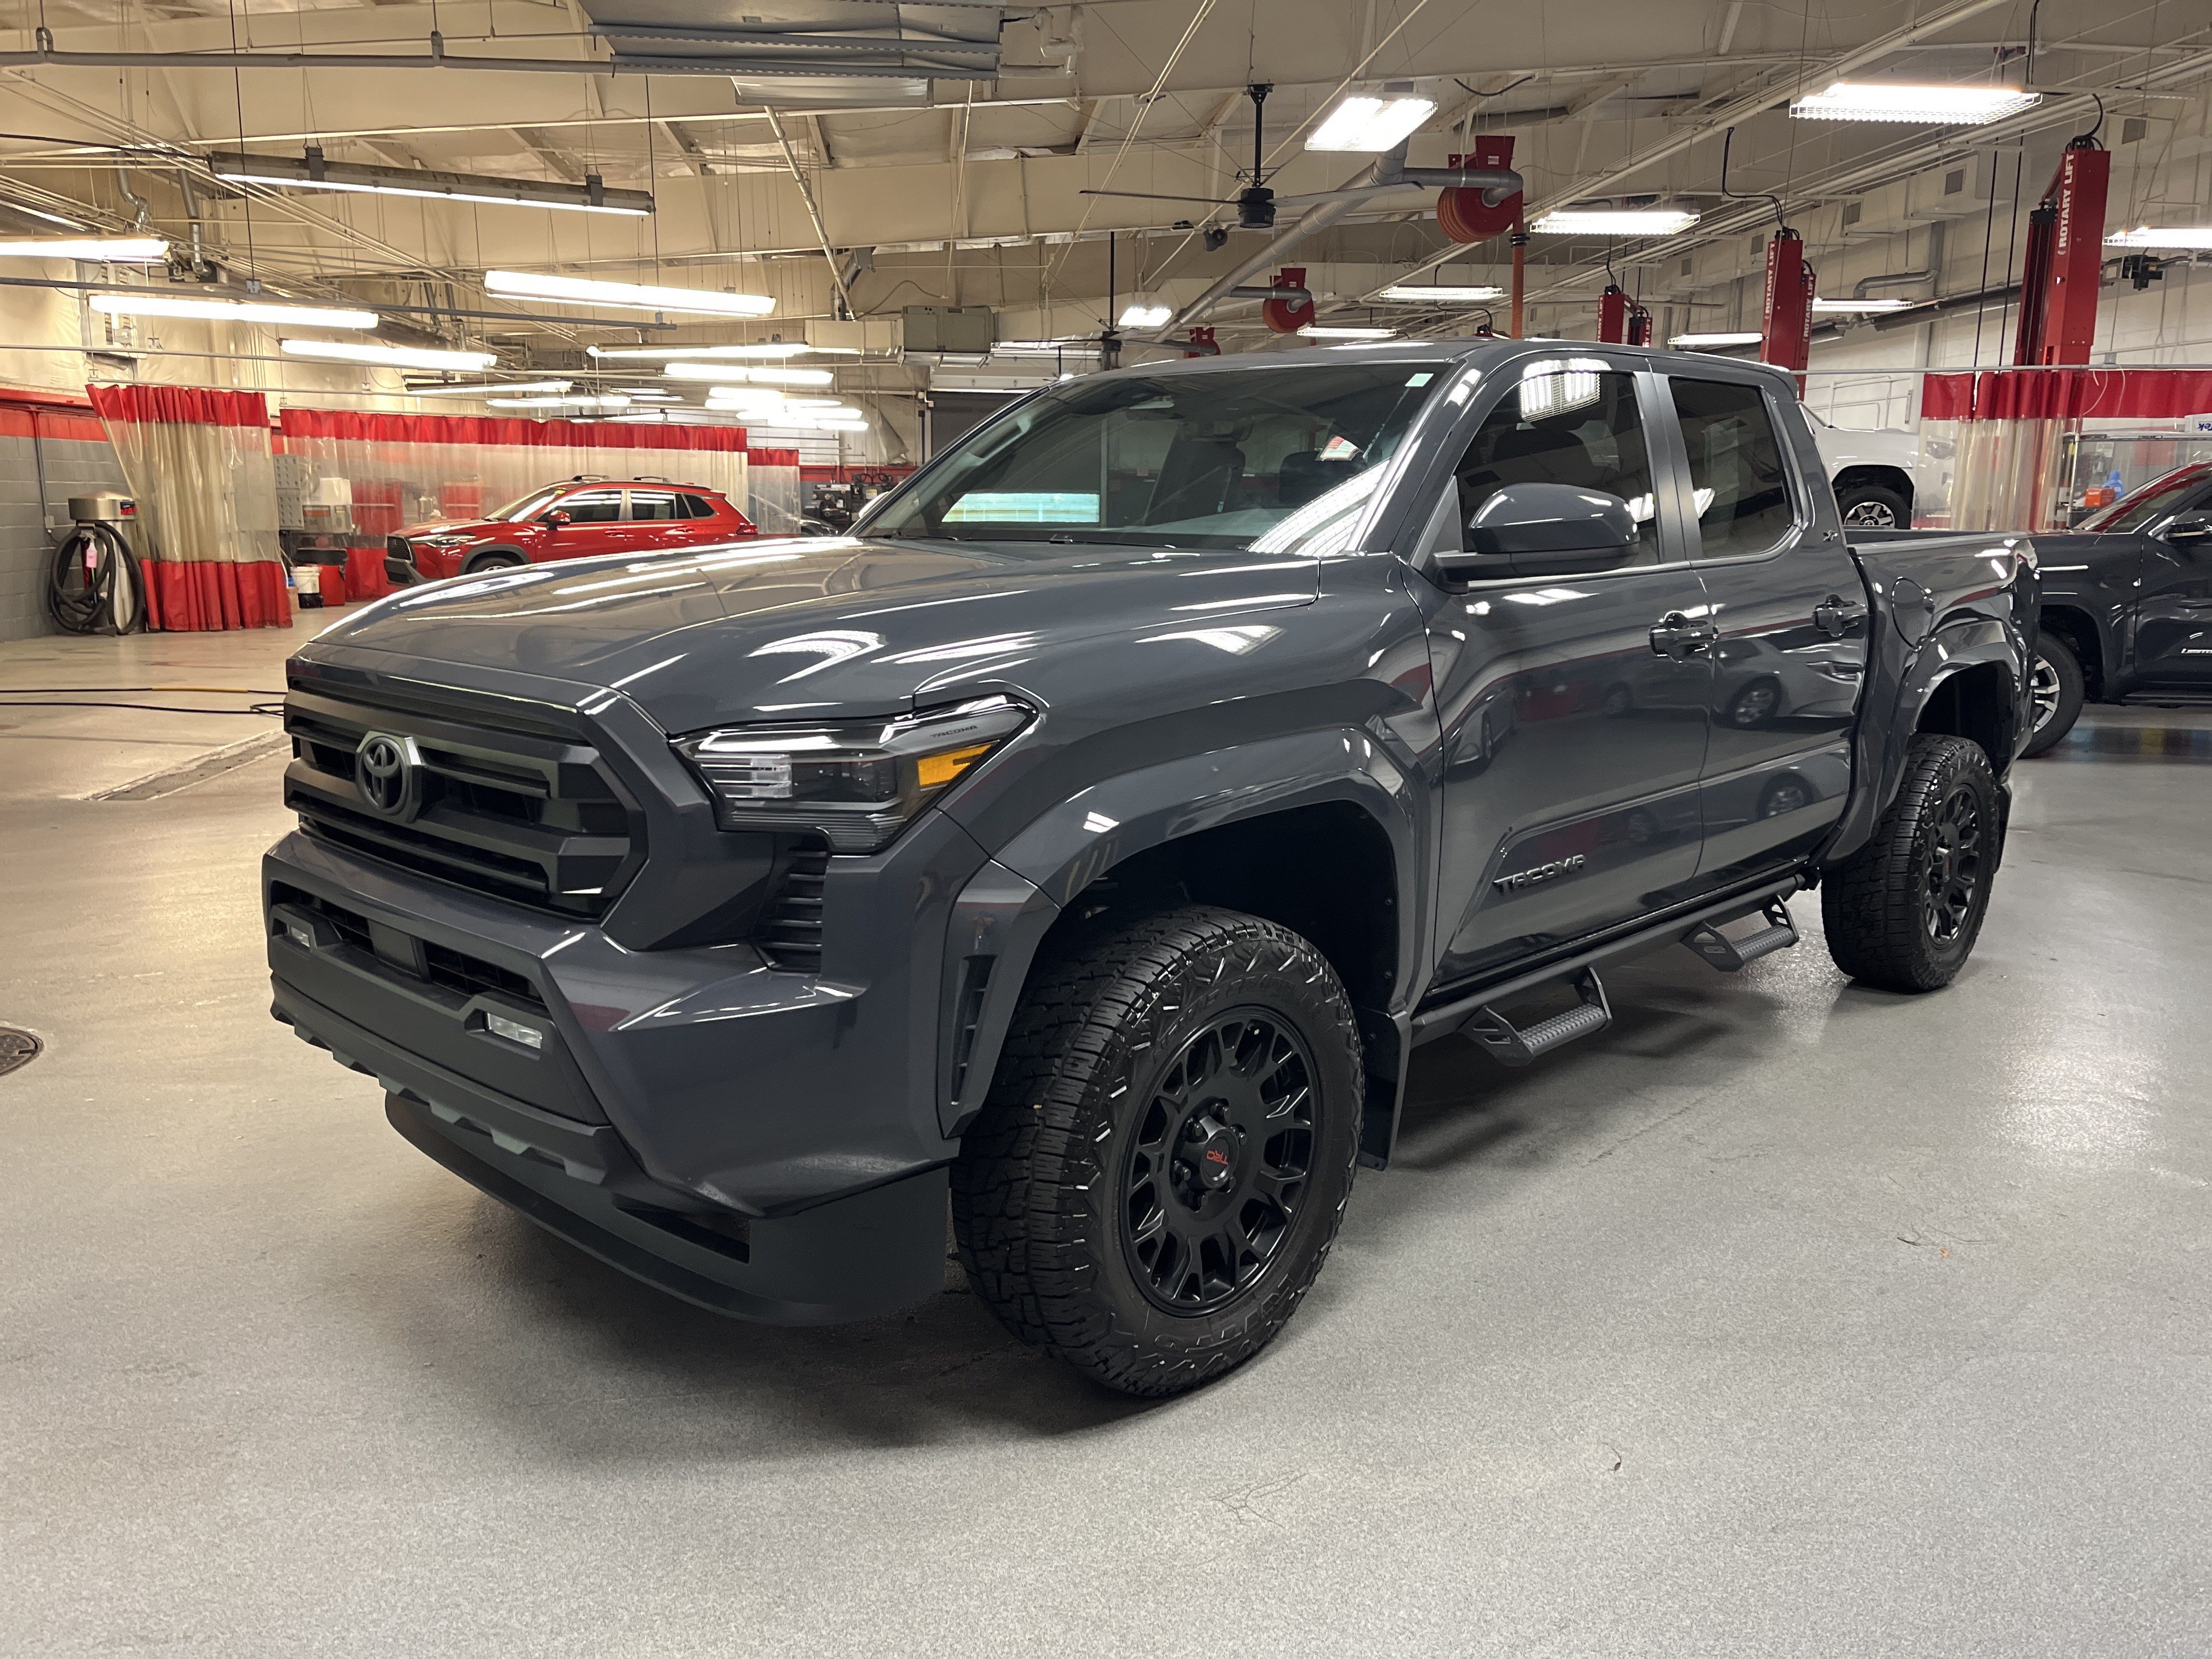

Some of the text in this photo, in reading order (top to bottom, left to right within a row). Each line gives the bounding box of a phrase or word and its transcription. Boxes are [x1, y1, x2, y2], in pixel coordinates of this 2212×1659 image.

[2059, 153, 2074, 248] ROTARY LIFT
[1765, 269, 1773, 314] ROTARY
[1803, 298, 1812, 338] ROTARY
[930, 725, 978, 738] TACOMA
[1493, 854, 1585, 894] TACOMA
[1206, 1149, 1228, 1166] TRD
